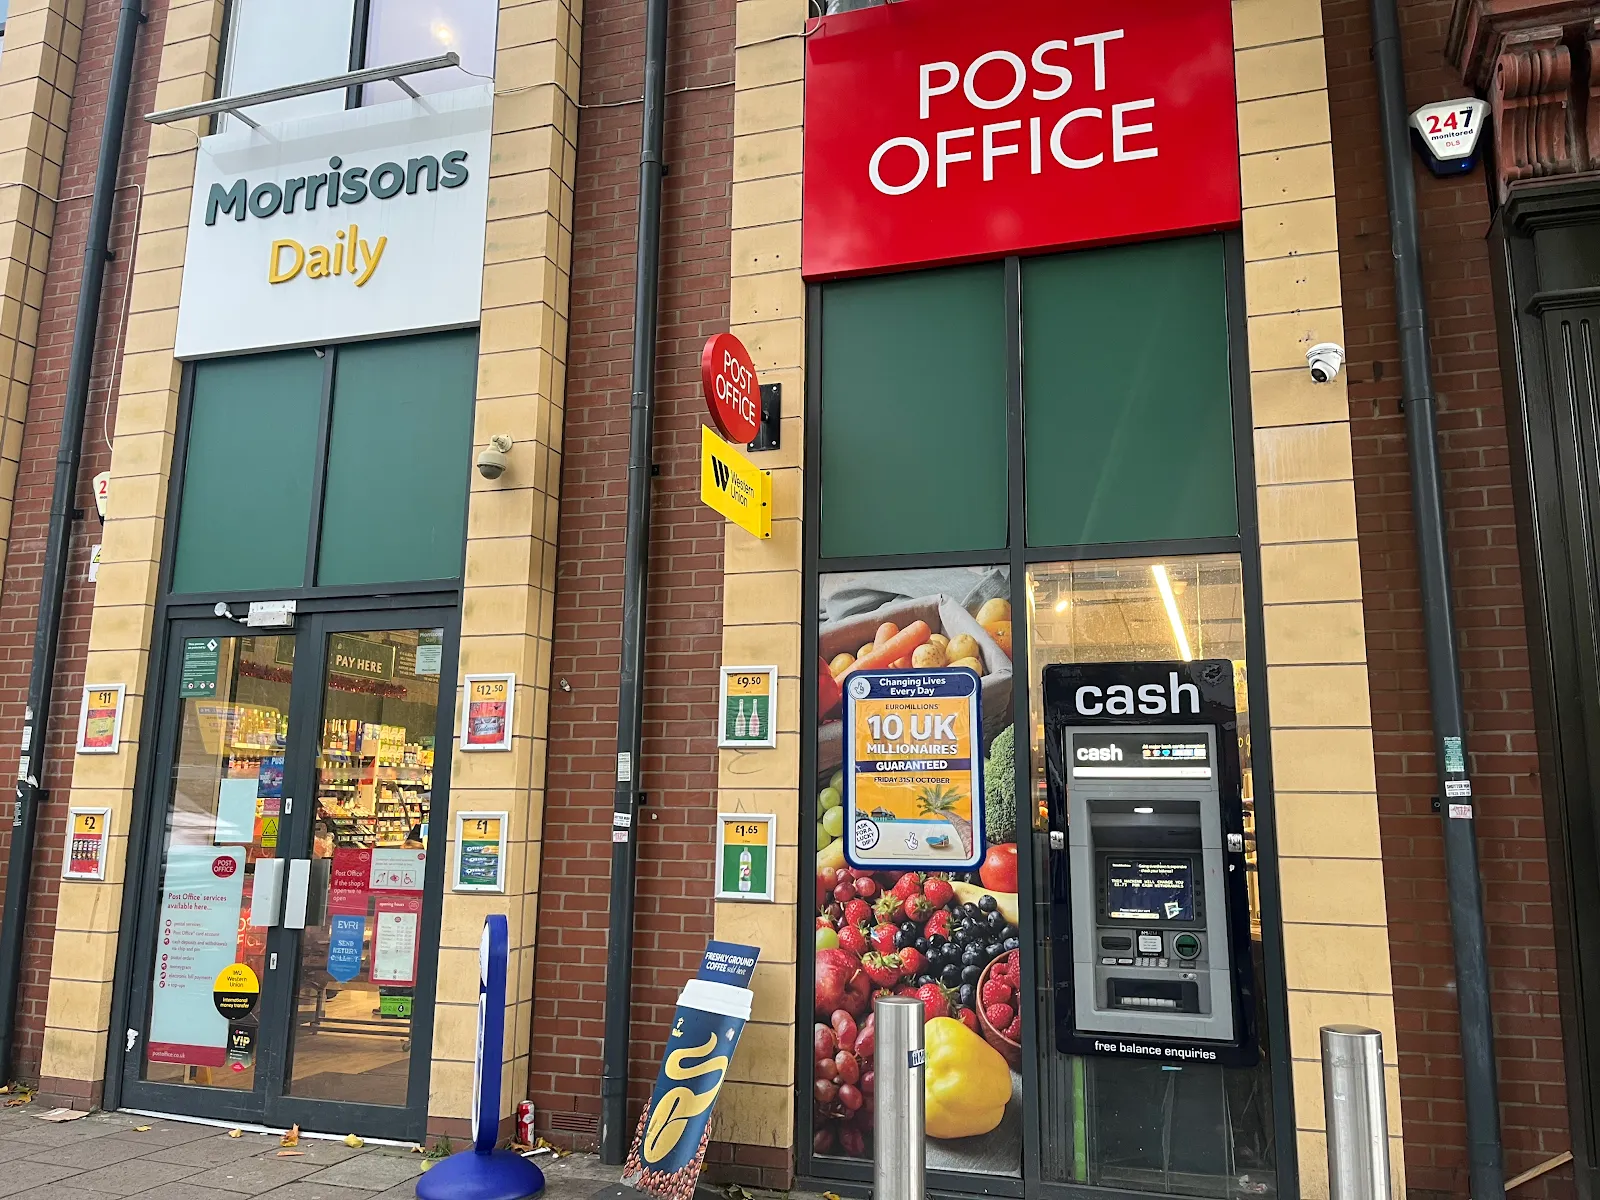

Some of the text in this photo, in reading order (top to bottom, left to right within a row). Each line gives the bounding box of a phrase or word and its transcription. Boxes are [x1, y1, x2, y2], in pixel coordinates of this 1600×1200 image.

[919, 28, 1124, 120] POST
[1426, 109, 1474, 135] 247
[1431, 128, 1474, 141] monitored
[868, 97, 1159, 196] OFFICE
[1445, 140, 1461, 148] DLS
[204, 149, 469, 226] Morrisons
[268, 223, 388, 288] Daily
[723, 349, 753, 395] POST
[715, 374, 756, 427] OFFICE
[730, 469, 755, 499] Western
[730, 483, 749, 508] Union
[335, 654, 355, 669] PAY
[356, 657, 383, 674] HERE
[737, 676, 762, 688] £9.50
[879, 676, 946, 687] Changing Lives
[476, 684, 504, 696] £12.50
[890, 686, 935, 697] Every Day
[1075, 671, 1200, 716] cash
[98, 692, 112, 704] £11
[866, 713, 958, 742] 10 UK
[866, 743, 958, 755] MILLIONAIRES
[1076, 743, 1123, 762] cash
[875, 760, 948, 771] GUARANTEED
[84, 816, 96, 830] £2
[476, 820, 488, 835] £1
[735, 825, 758, 837] £1.65
[213, 865, 234, 873] OFFICE
[217, 859, 233, 867] POST
[334, 869, 346, 877] Post
[339, 879, 348, 887] the
[168, 892, 181, 900] Post
[167, 902, 193, 910] available
[337, 939, 355, 947] SEND
[704, 951, 755, 968] FRESHLY GROUND
[705, 961, 728, 973] COFFEE
[152, 1050, 186, 1059] postoffice.co.uk
[1094, 1040, 1217, 1061] free balance enquiries
